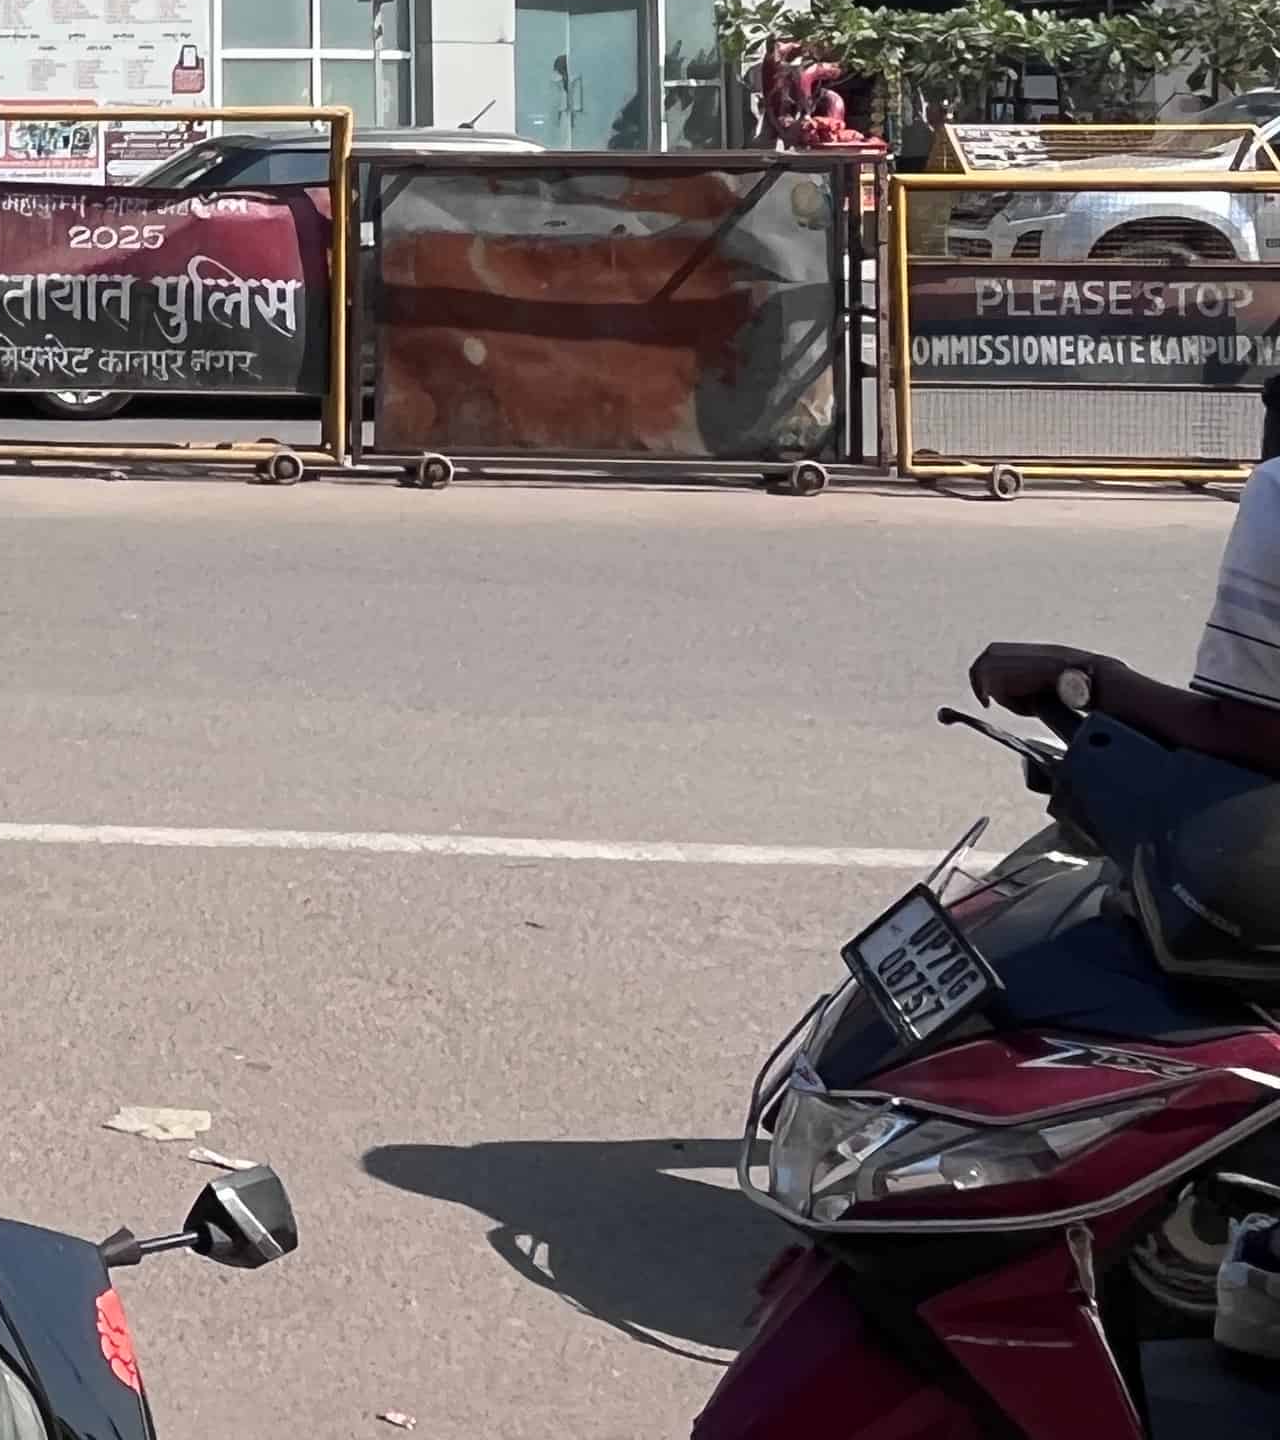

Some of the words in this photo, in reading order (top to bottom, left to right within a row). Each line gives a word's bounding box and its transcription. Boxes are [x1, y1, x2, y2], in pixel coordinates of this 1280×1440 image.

[67, 224, 167, 250] 2025
[150, 254, 303, 344] पुलिस
[974, 278, 1133, 317] PLEASE
[1142, 281, 1254, 318] STOP
[97, 348, 186, 380] कानपुर
[190, 348, 262, 379] नगर
[912, 334, 1145, 367] OMMISSIONERATE
